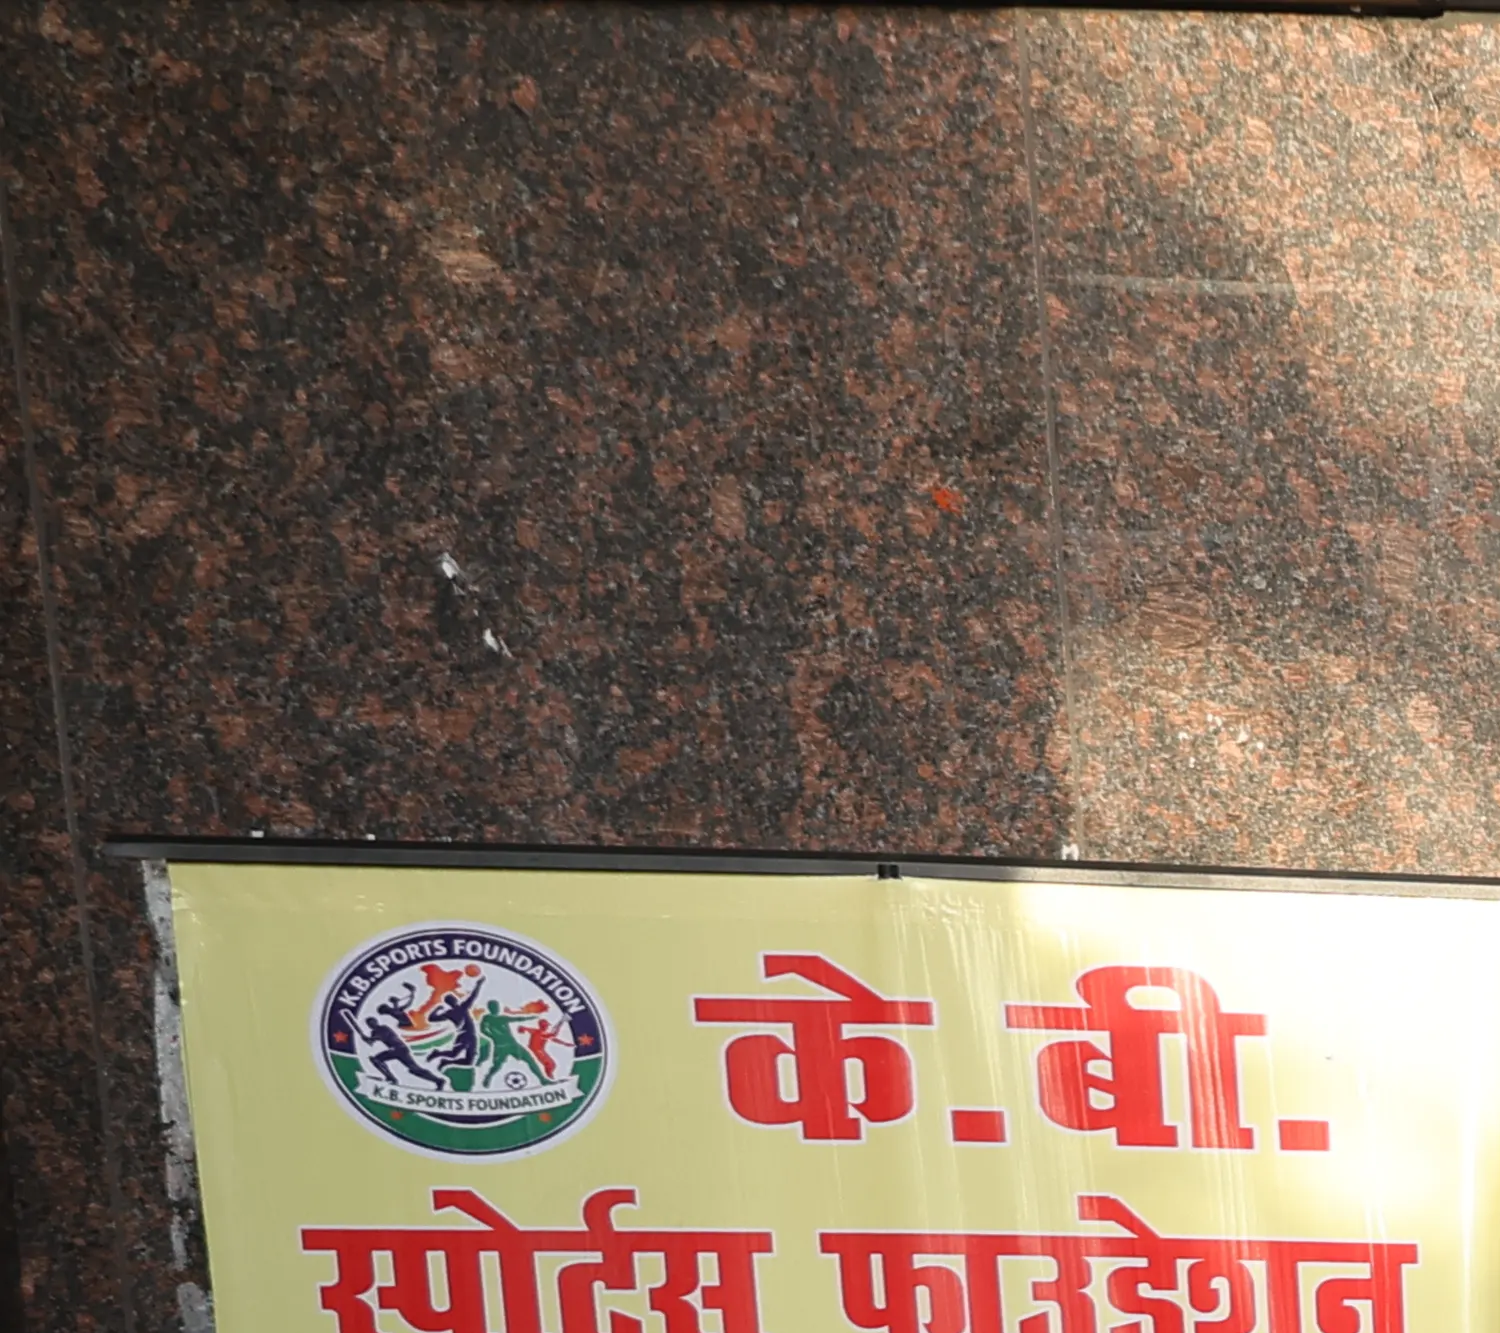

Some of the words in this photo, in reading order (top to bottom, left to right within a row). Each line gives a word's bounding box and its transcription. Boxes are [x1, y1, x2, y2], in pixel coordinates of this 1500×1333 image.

[453, 938, 587, 1015] FOUNDATION
[406, 1091, 464, 1111] SPORTS
[468, 1087, 567, 1111] FOUNDATION
